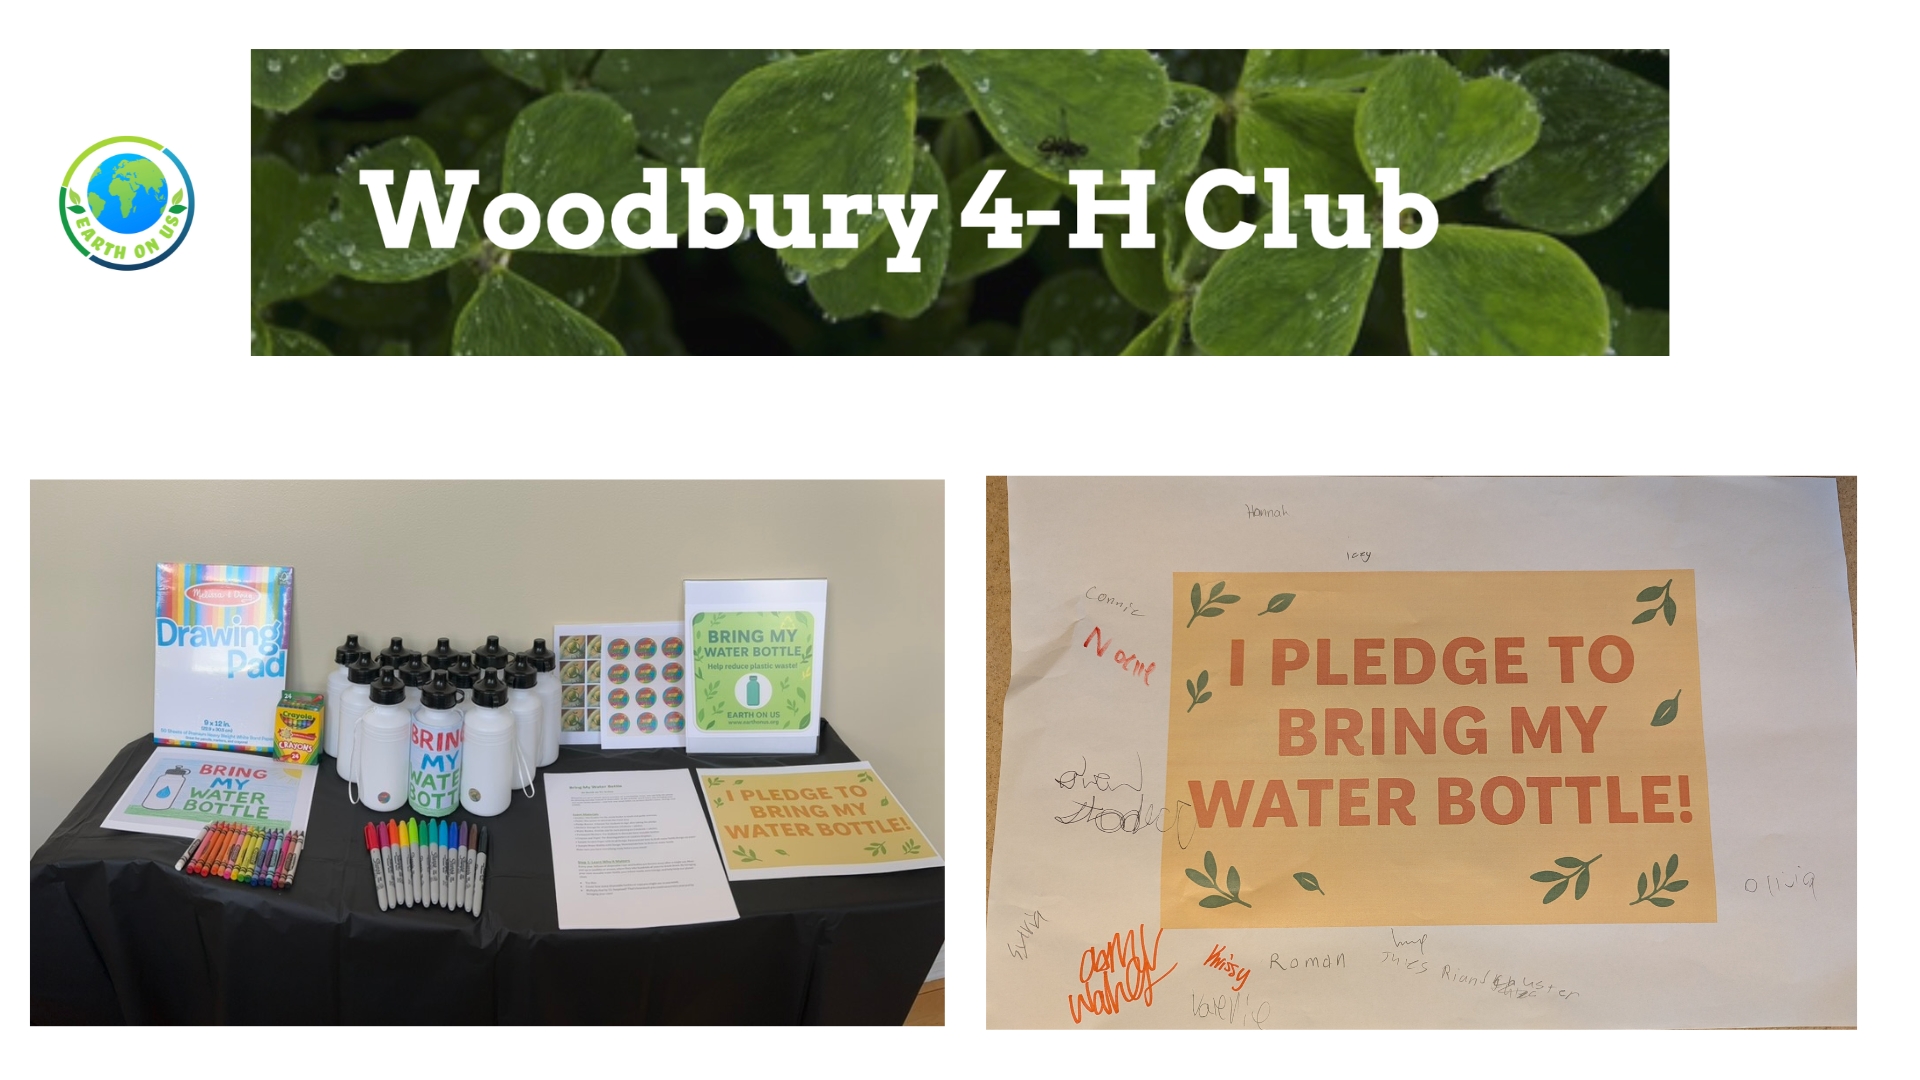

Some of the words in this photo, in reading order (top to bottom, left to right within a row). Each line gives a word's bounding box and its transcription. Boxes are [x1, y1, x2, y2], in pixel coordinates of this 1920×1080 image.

[1245, 504, 1290, 519] Hannah
[192, 588, 224, 599] Melissa
[157, 615, 282, 656] Drawing
[708, 629, 764, 644] BRING
[770, 629, 798, 643] MY
[704, 647, 749, 657] WATER
[753, 646, 802, 657] BOTTLE
[227, 649, 286, 679] Pad
[750, 663, 773, 671] plastic
[1229, 638, 1245, 686] I
[1271, 636, 1528, 686] PLEDGE
[1548, 635, 1635, 684] TO
[283, 711, 312, 719] Crayola
[727, 711, 754, 719] EARTH
[1278, 705, 1488, 757] BRING
[1510, 705, 1608, 754] MY
[279, 741, 313, 753] CRAYONS
[421, 750, 459, 772] MY
[199, 764, 268, 779] BRING
[210, 777, 250, 791] MY
[189, 787, 265, 804] WATER
[726, 790, 734, 801] I
[740, 787, 833, 801] PLEDGE
[834, 785, 868, 799] TO
[1187, 776, 1417, 828] WATER
[1437, 774, 1693, 827] BOTTLE!
[183, 799, 270, 819] BOTTLE
[750, 805, 829, 819] BRING
[831, 802, 868, 817] MY
[724, 822, 814, 840] WATER
[817, 817, 912, 837] BOTTLE!
[1269, 952, 1346, 971] Roman
